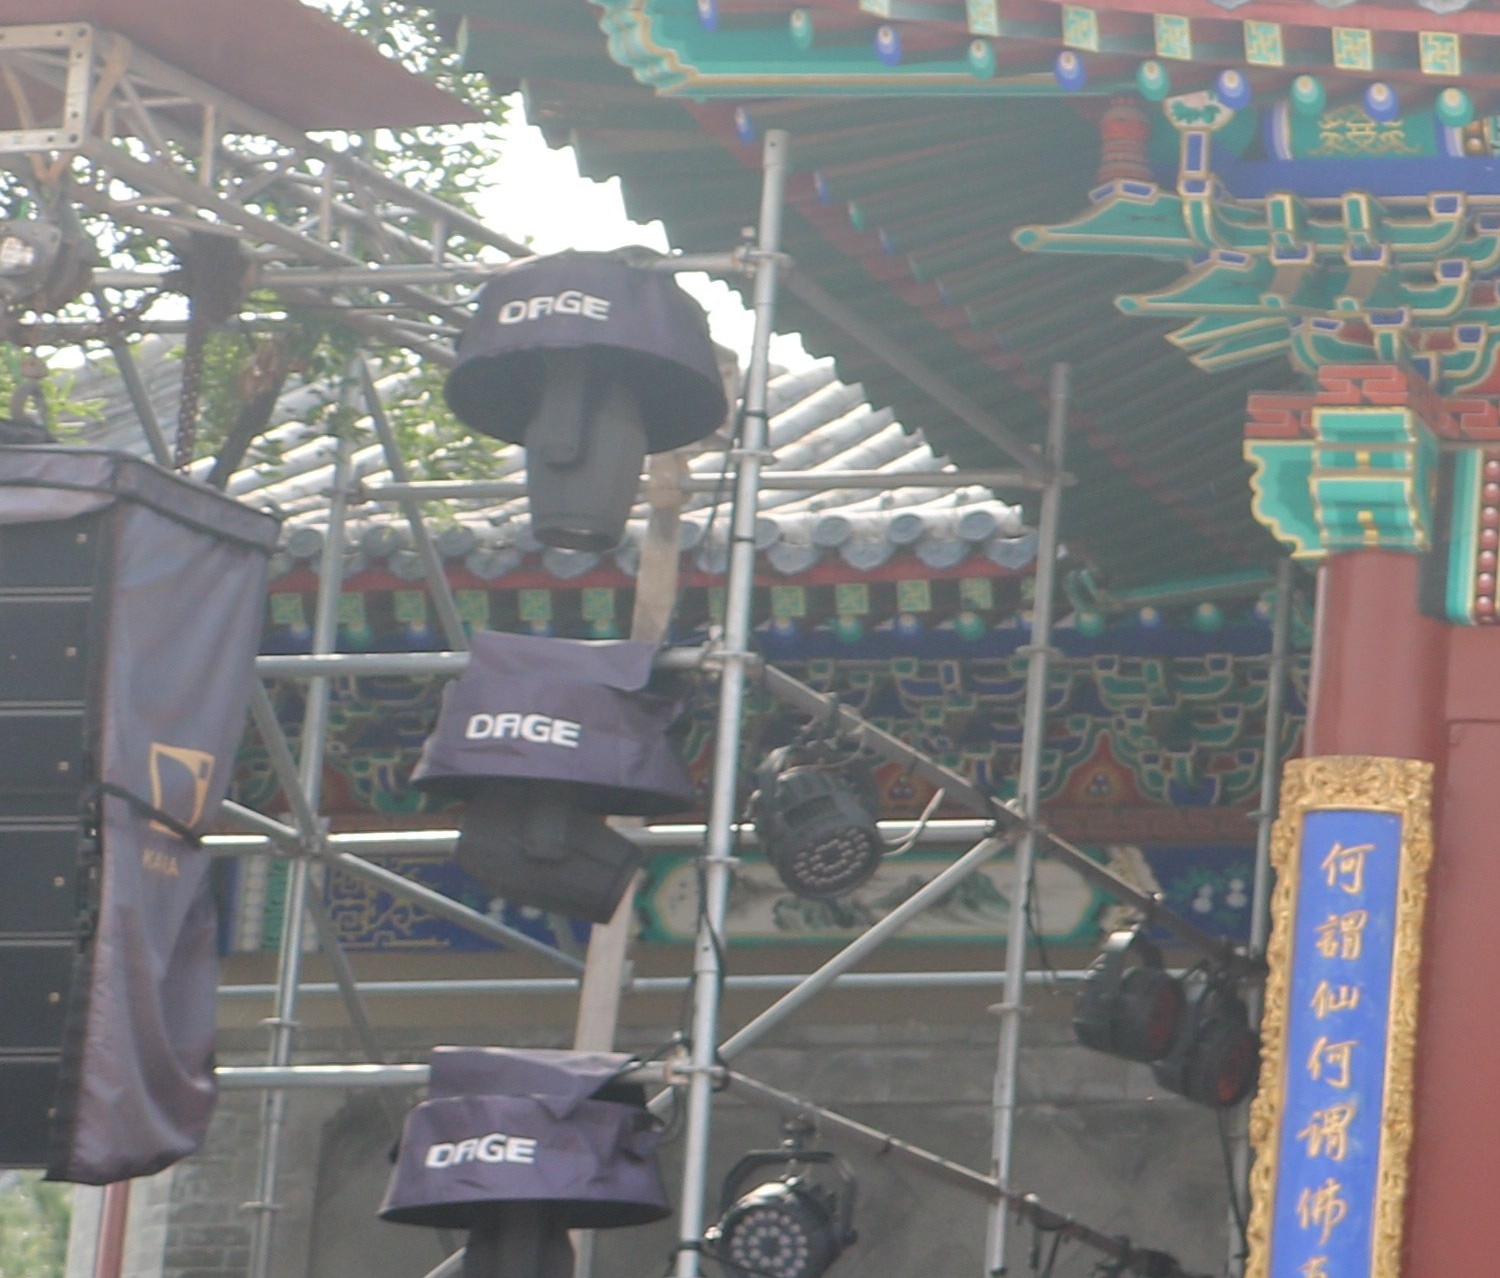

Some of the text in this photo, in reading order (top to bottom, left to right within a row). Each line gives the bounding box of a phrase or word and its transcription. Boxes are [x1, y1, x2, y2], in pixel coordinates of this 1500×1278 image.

[498, 289, 611, 325] DAGE
[465, 712, 582, 749] DAGE
[425, 1131, 538, 1170] DAGE
